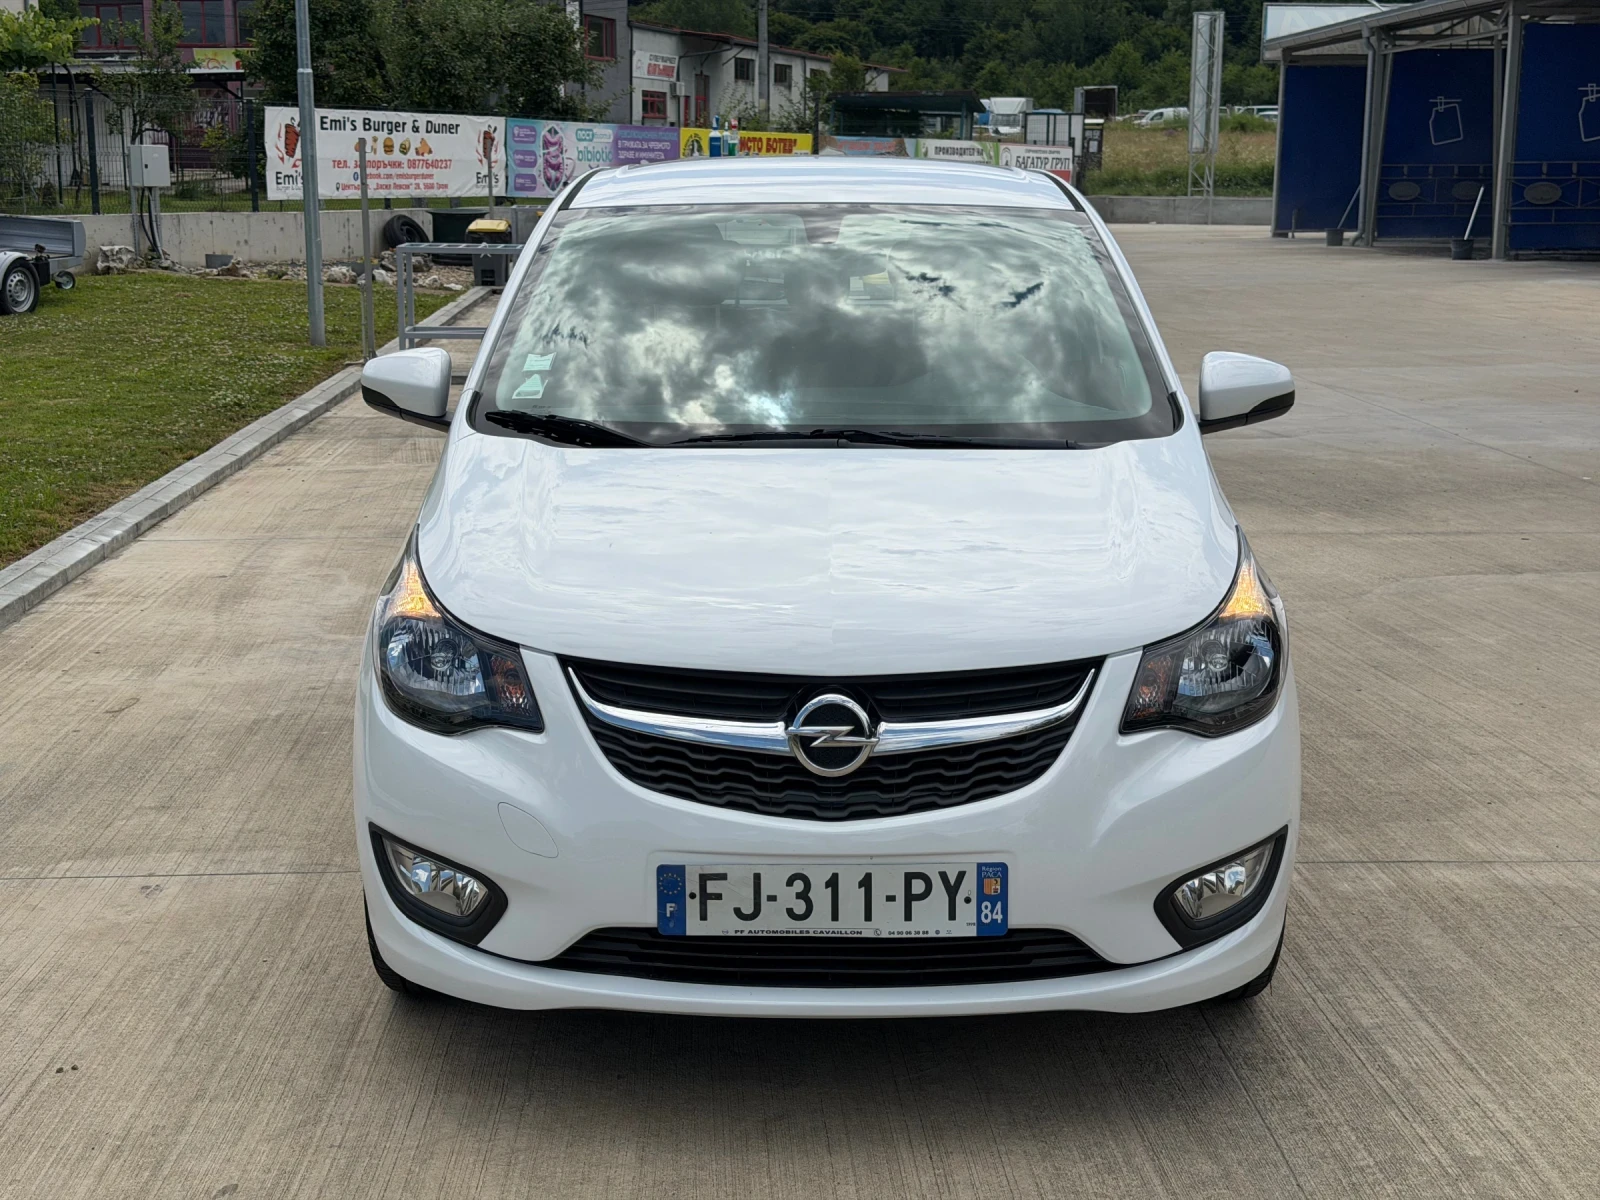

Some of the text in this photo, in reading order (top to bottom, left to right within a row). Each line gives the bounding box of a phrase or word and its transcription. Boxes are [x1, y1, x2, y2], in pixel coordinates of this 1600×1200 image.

[320, 116, 460, 135] Emi's Burger & Duner
[740, 136, 763, 153] ИСТО
[576, 146, 613, 162] bibiotic
[332, 160, 350, 168] тел.
[366, 160, 404, 170] поръчки:
[1015, 155, 1070, 170] БАГАТУР ГРУП
[476, 172, 499, 184] Em's
[698, 870, 967, 922] FJ-311-PY
[666, 903, 676, 917] F
[981, 901, 1003, 923] 84
